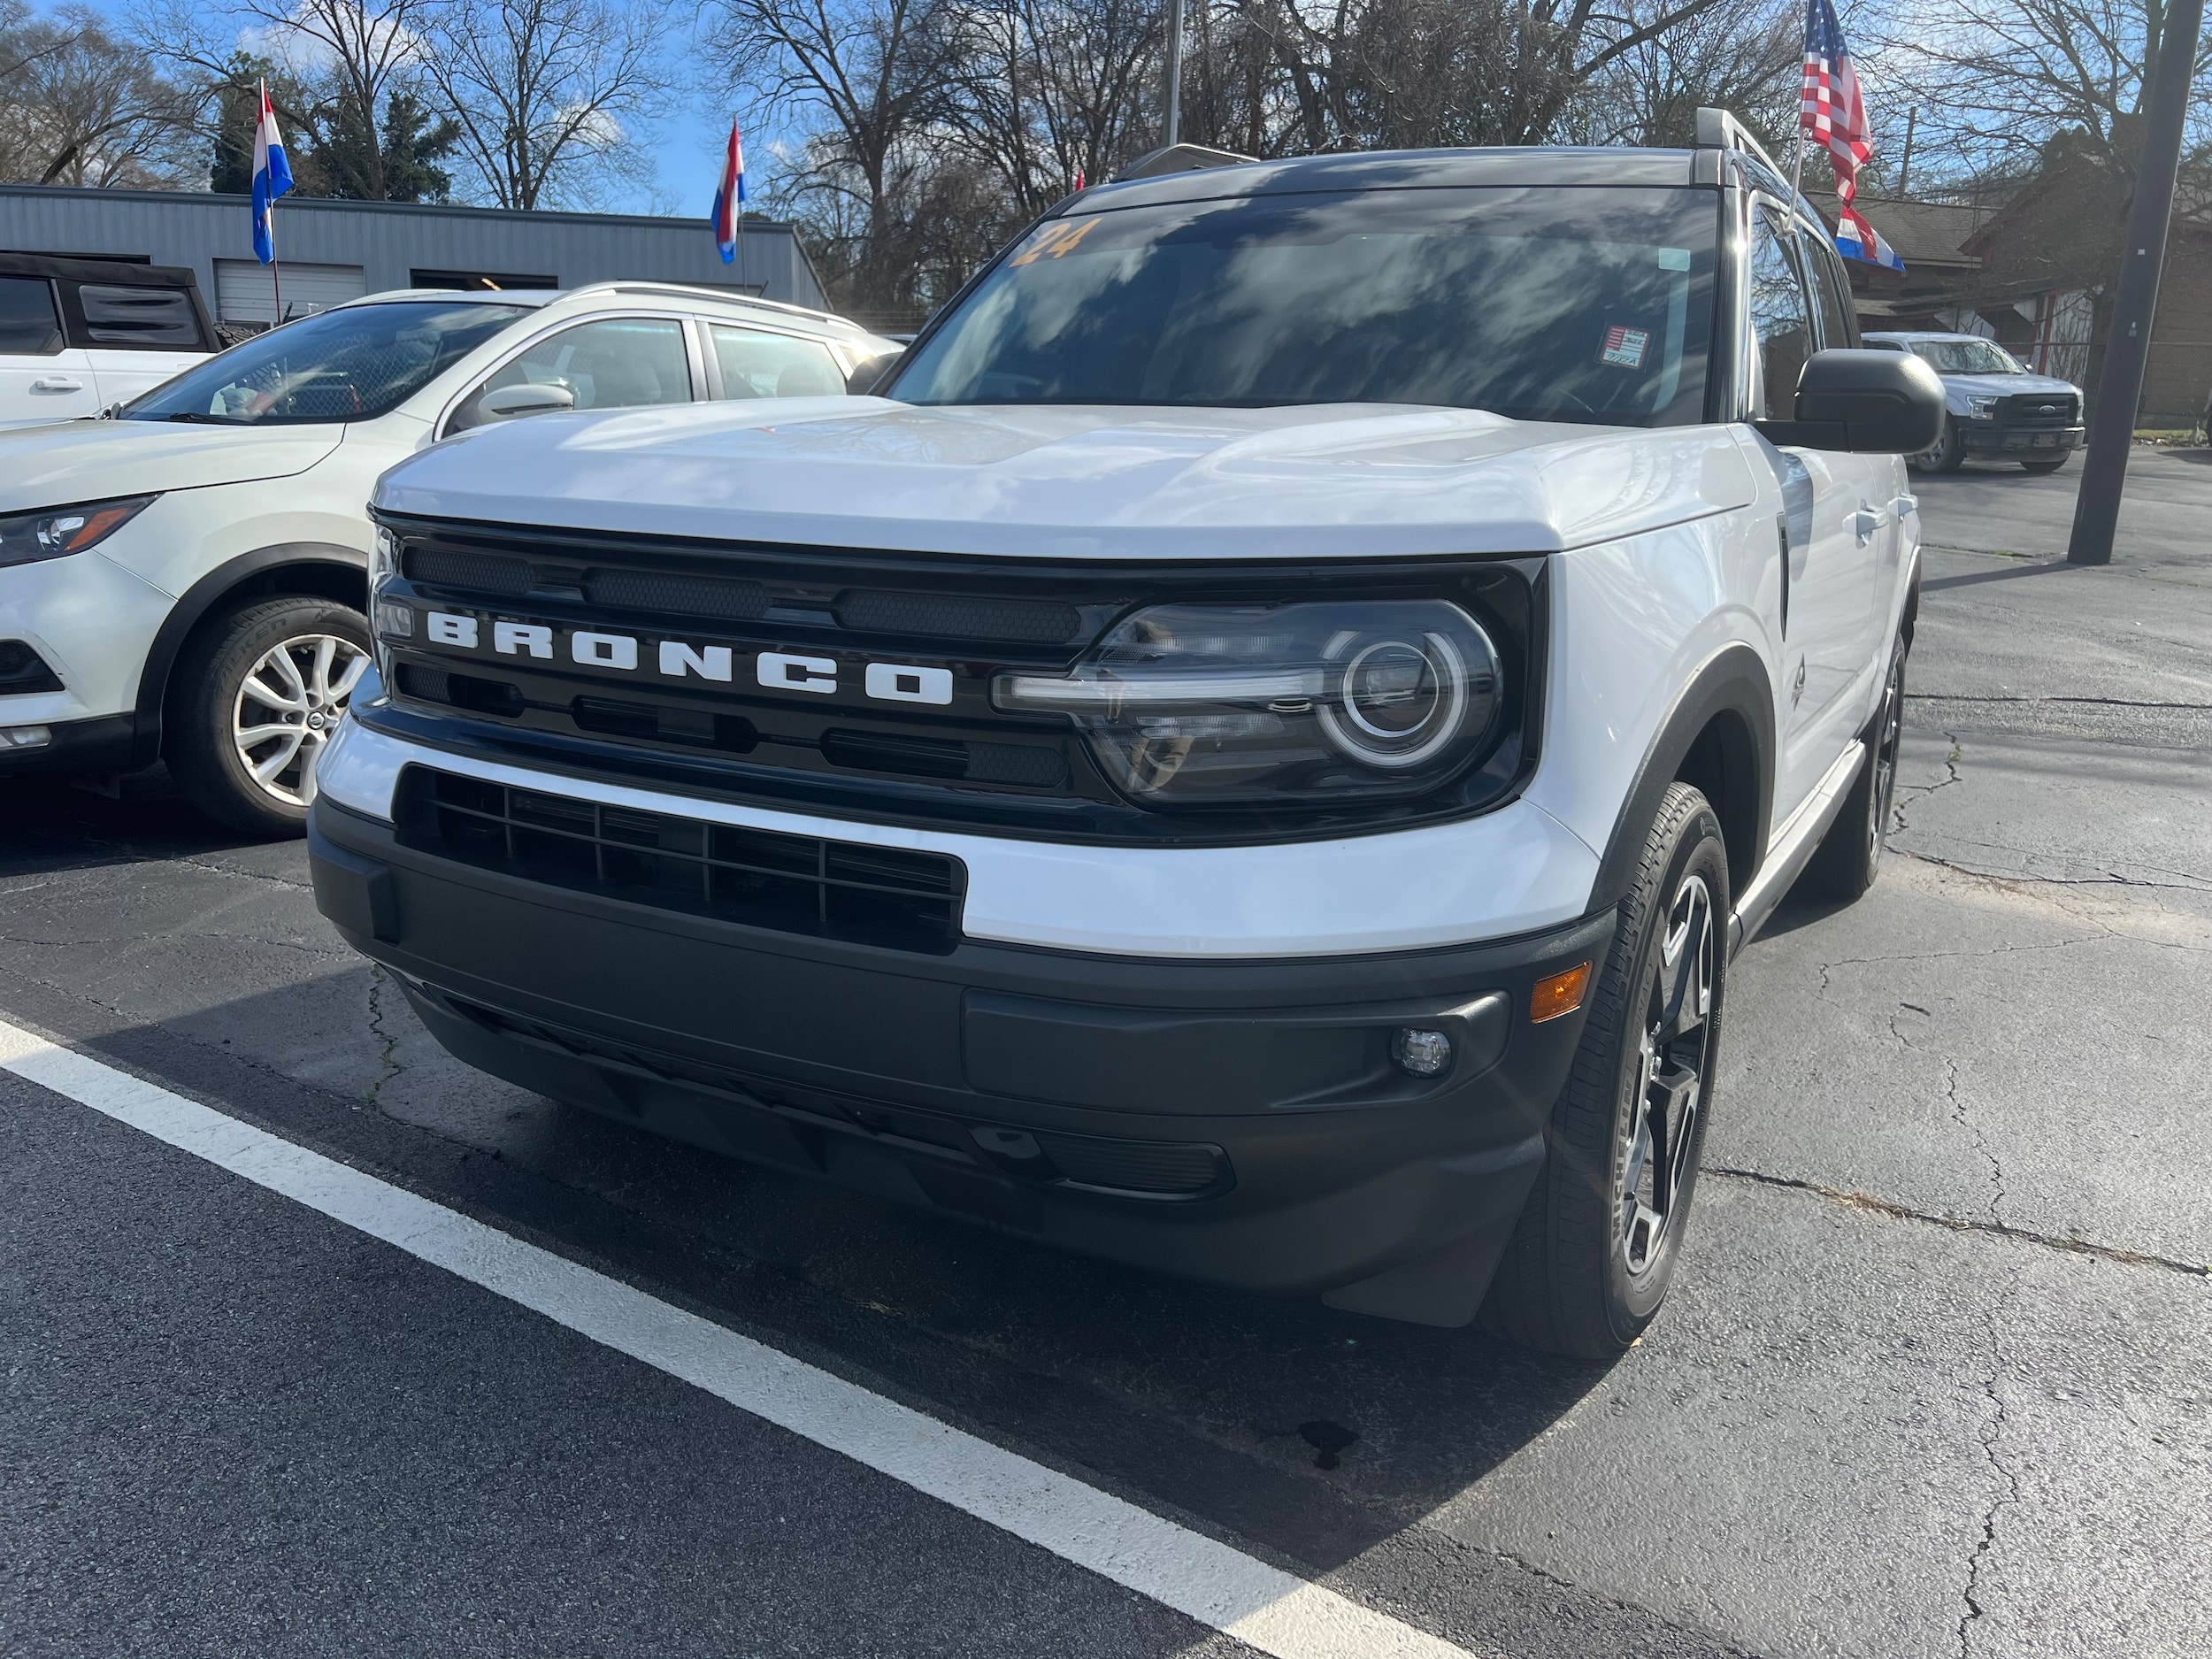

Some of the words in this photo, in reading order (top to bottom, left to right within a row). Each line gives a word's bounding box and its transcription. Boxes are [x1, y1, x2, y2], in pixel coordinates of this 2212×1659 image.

[1009, 218, 1104, 268] 24
[427, 611, 954, 705] BRONCO
[1611, 1079, 1632, 1240] MICHELIN
